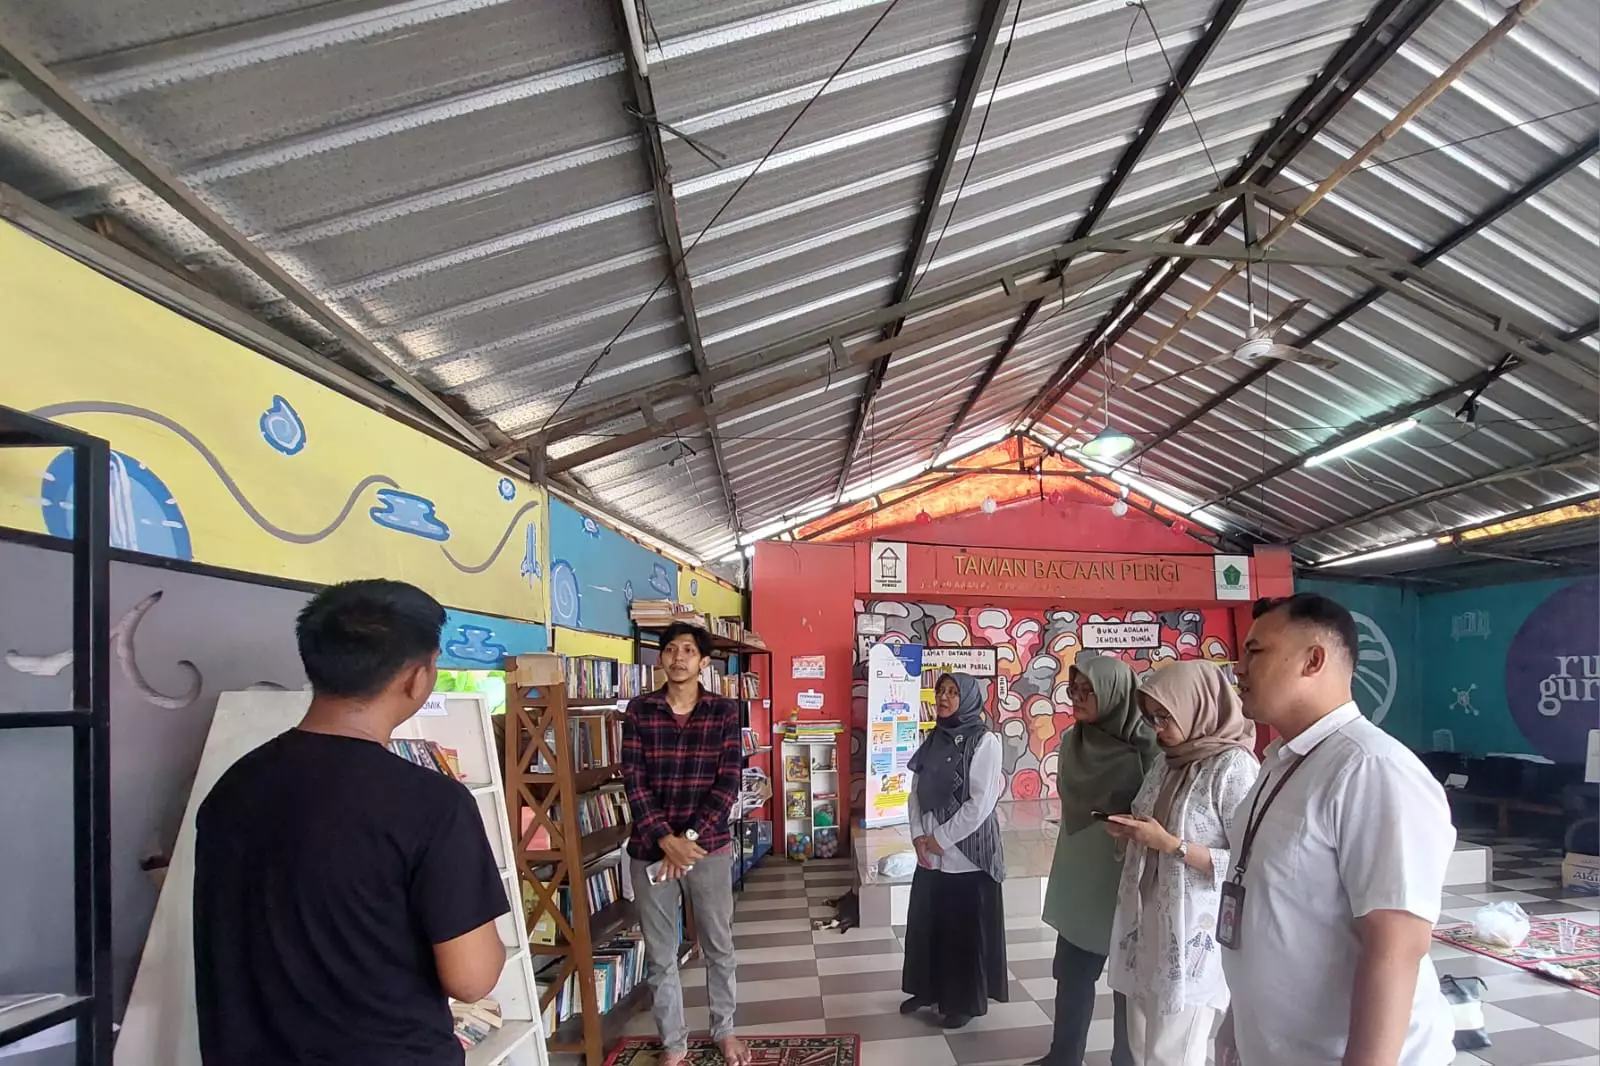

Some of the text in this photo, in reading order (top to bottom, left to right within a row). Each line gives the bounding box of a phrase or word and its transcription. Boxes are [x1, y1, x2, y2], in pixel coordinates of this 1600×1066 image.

[953, 555, 1180, 582] TAMAN BACAAN PERIGI
